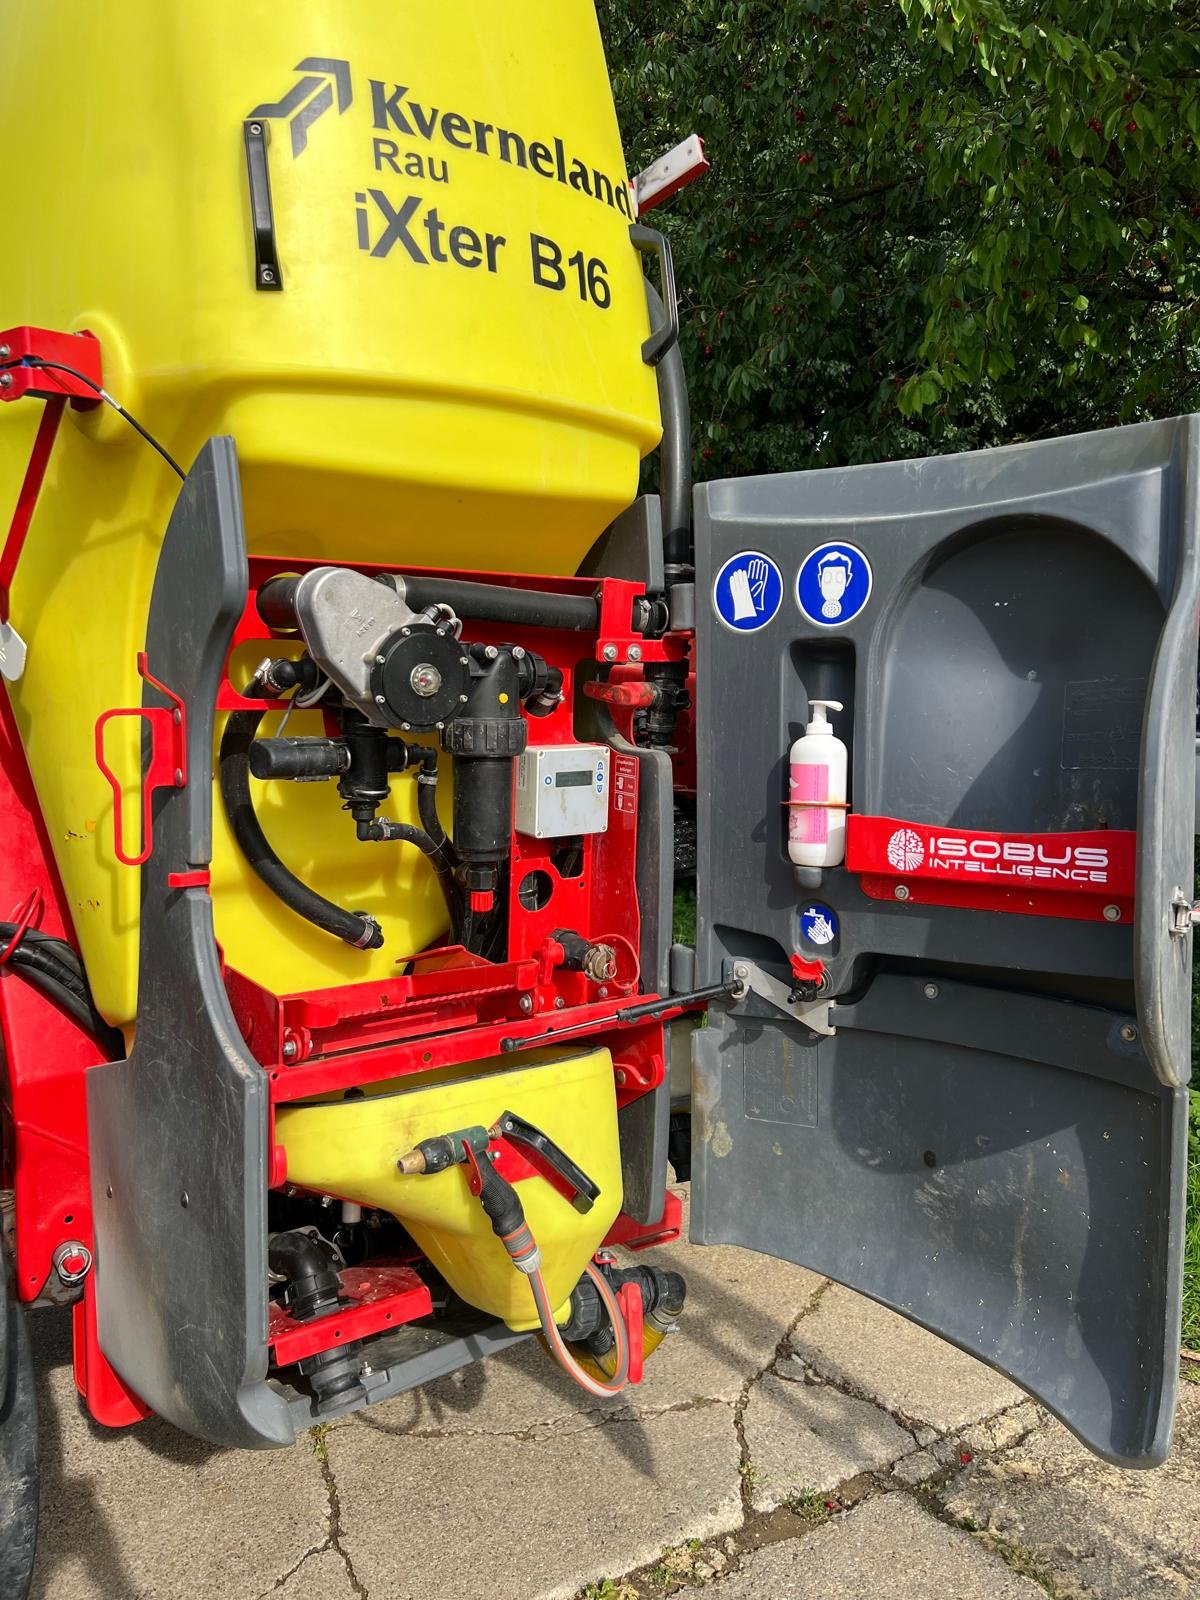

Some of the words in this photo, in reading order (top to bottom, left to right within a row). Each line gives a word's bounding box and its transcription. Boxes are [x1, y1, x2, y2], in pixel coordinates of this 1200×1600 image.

[369, 80, 633, 222] Kverneland
[373, 138, 449, 184] Rau
[355, 188, 506, 273] iXter
[529, 232, 612, 310] B16
[929, 837, 1109, 867] ISOBUS
[929, 858, 1108, 883] INTELLIGENCE
